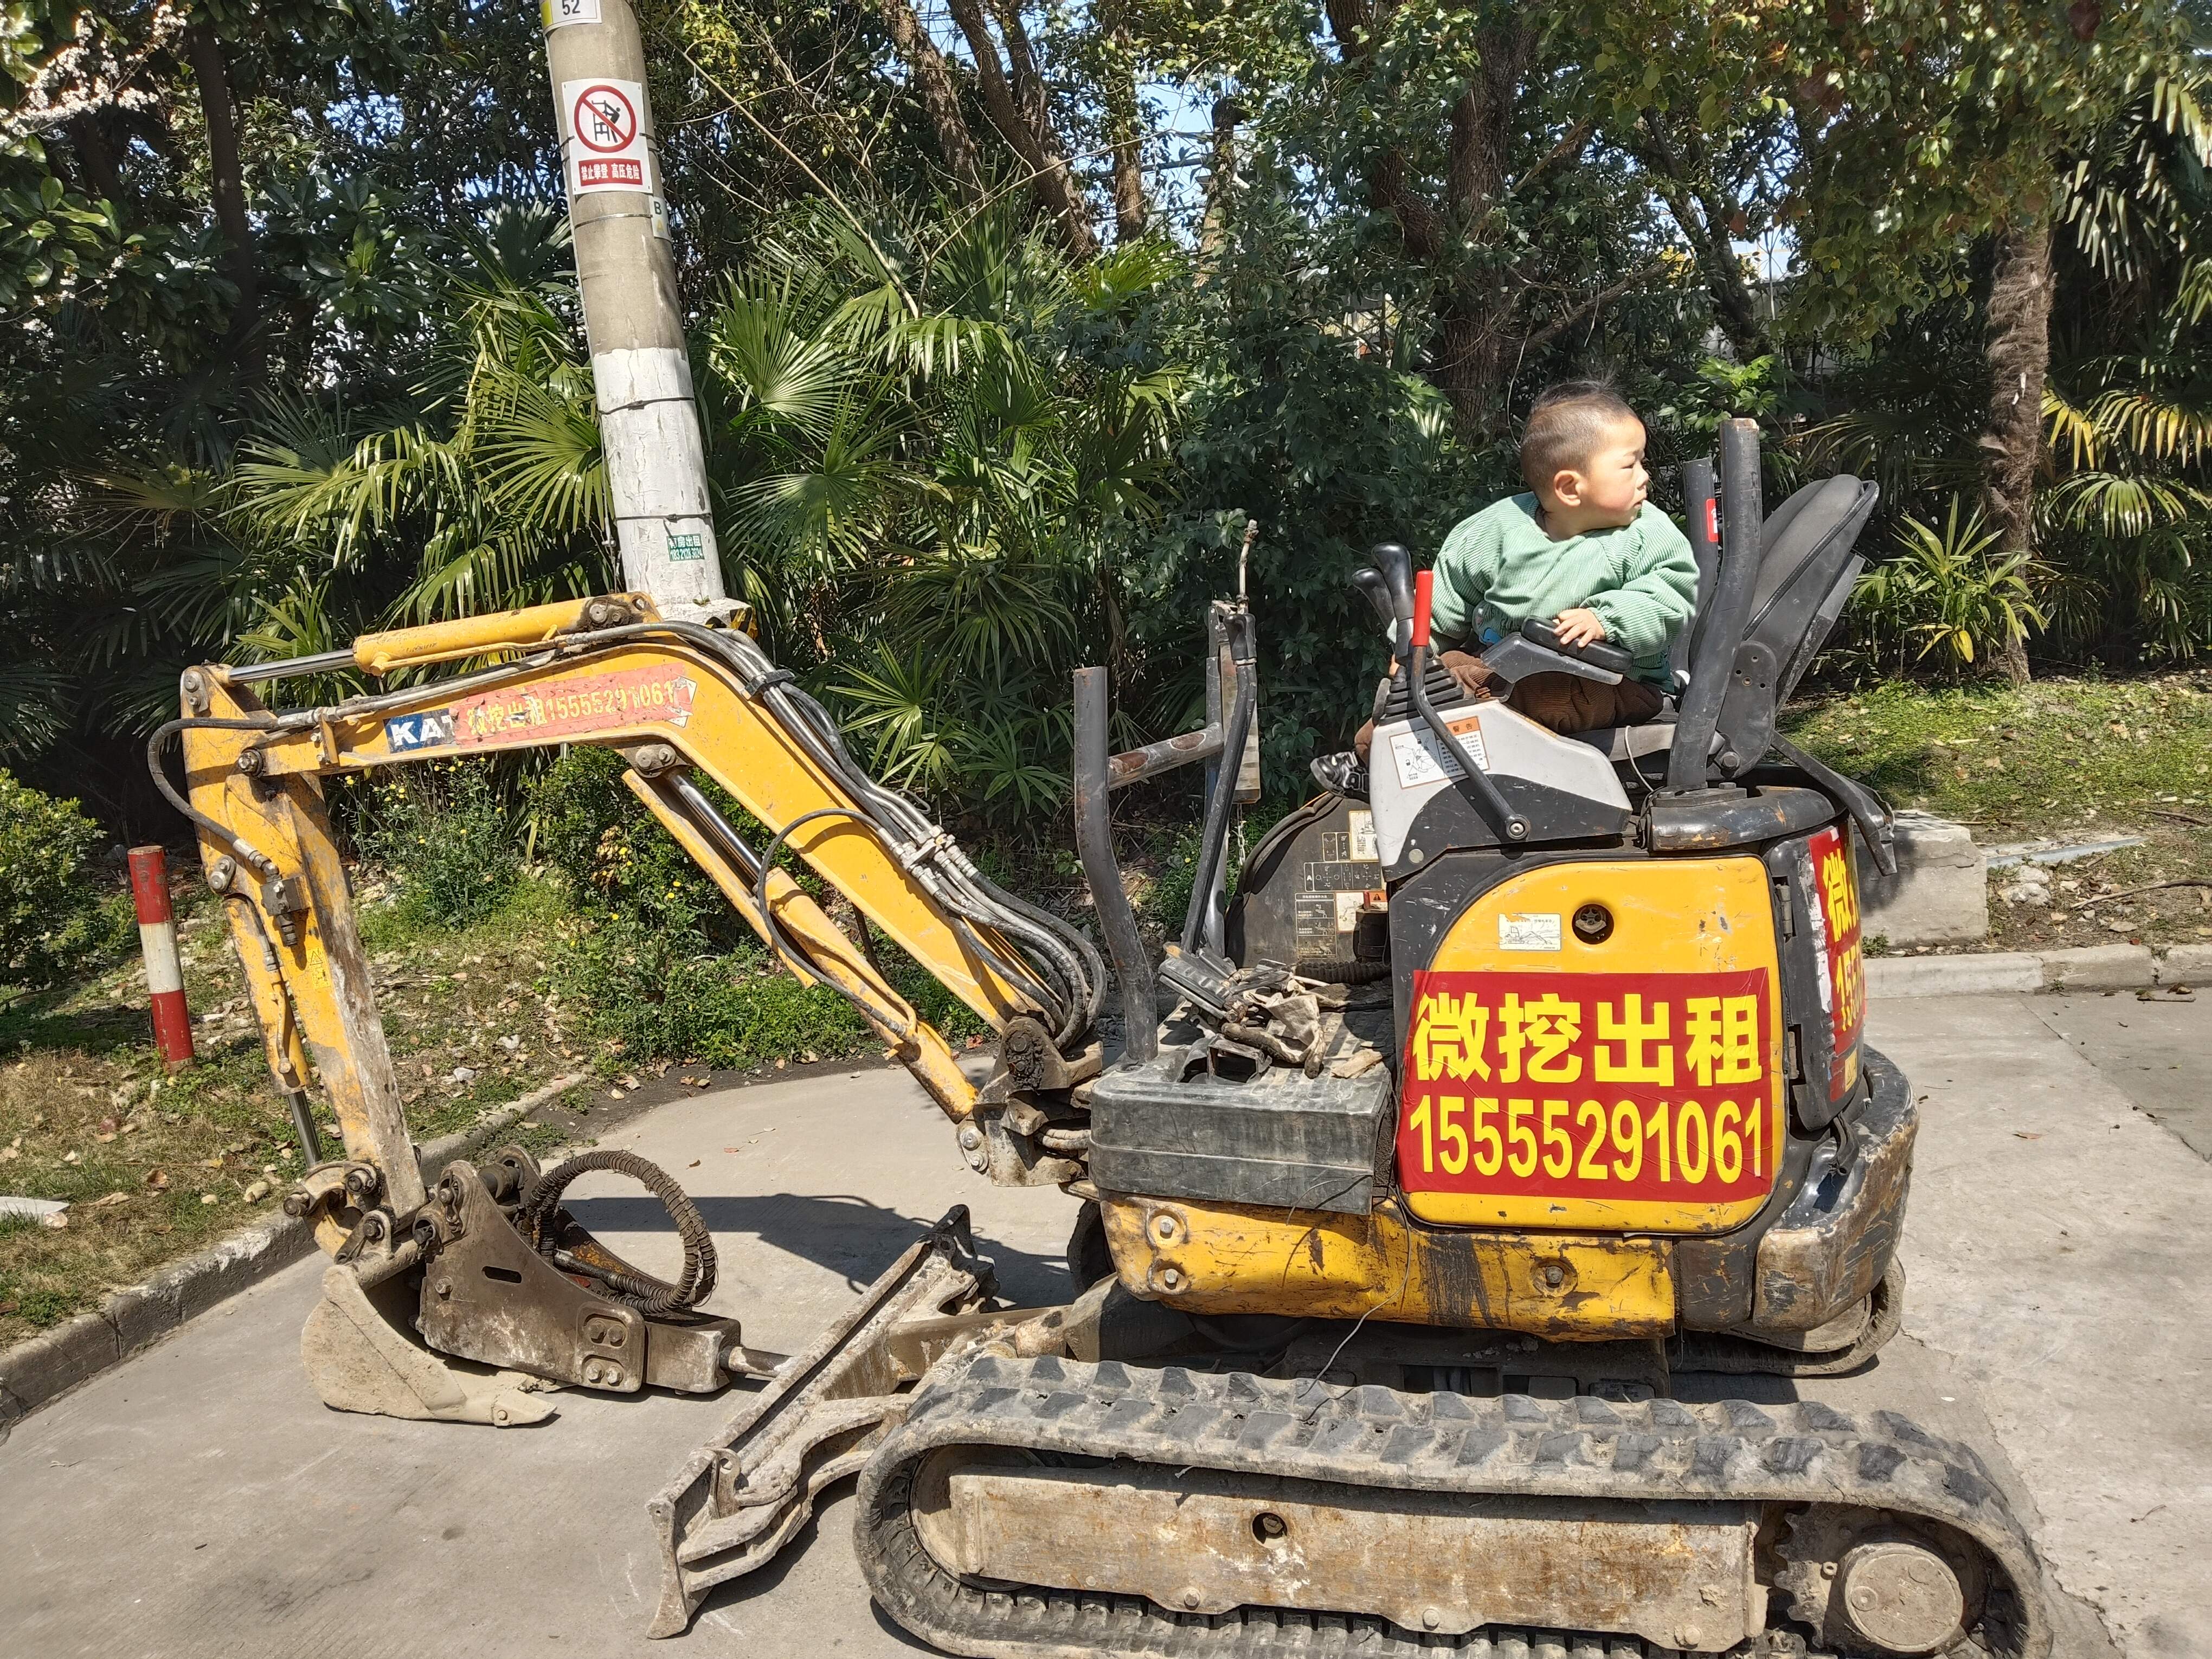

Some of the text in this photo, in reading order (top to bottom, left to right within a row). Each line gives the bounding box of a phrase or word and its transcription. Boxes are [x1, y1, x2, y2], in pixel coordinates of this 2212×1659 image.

[562, 0, 581, 15] 52
[581, 163, 640, 181] 禁止攀登 高压危险
[654, 201, 662, 215] B
[1413, 993, 1763, 1086] 微挖出租
[1410, 1095, 1761, 1185] 15555291061
